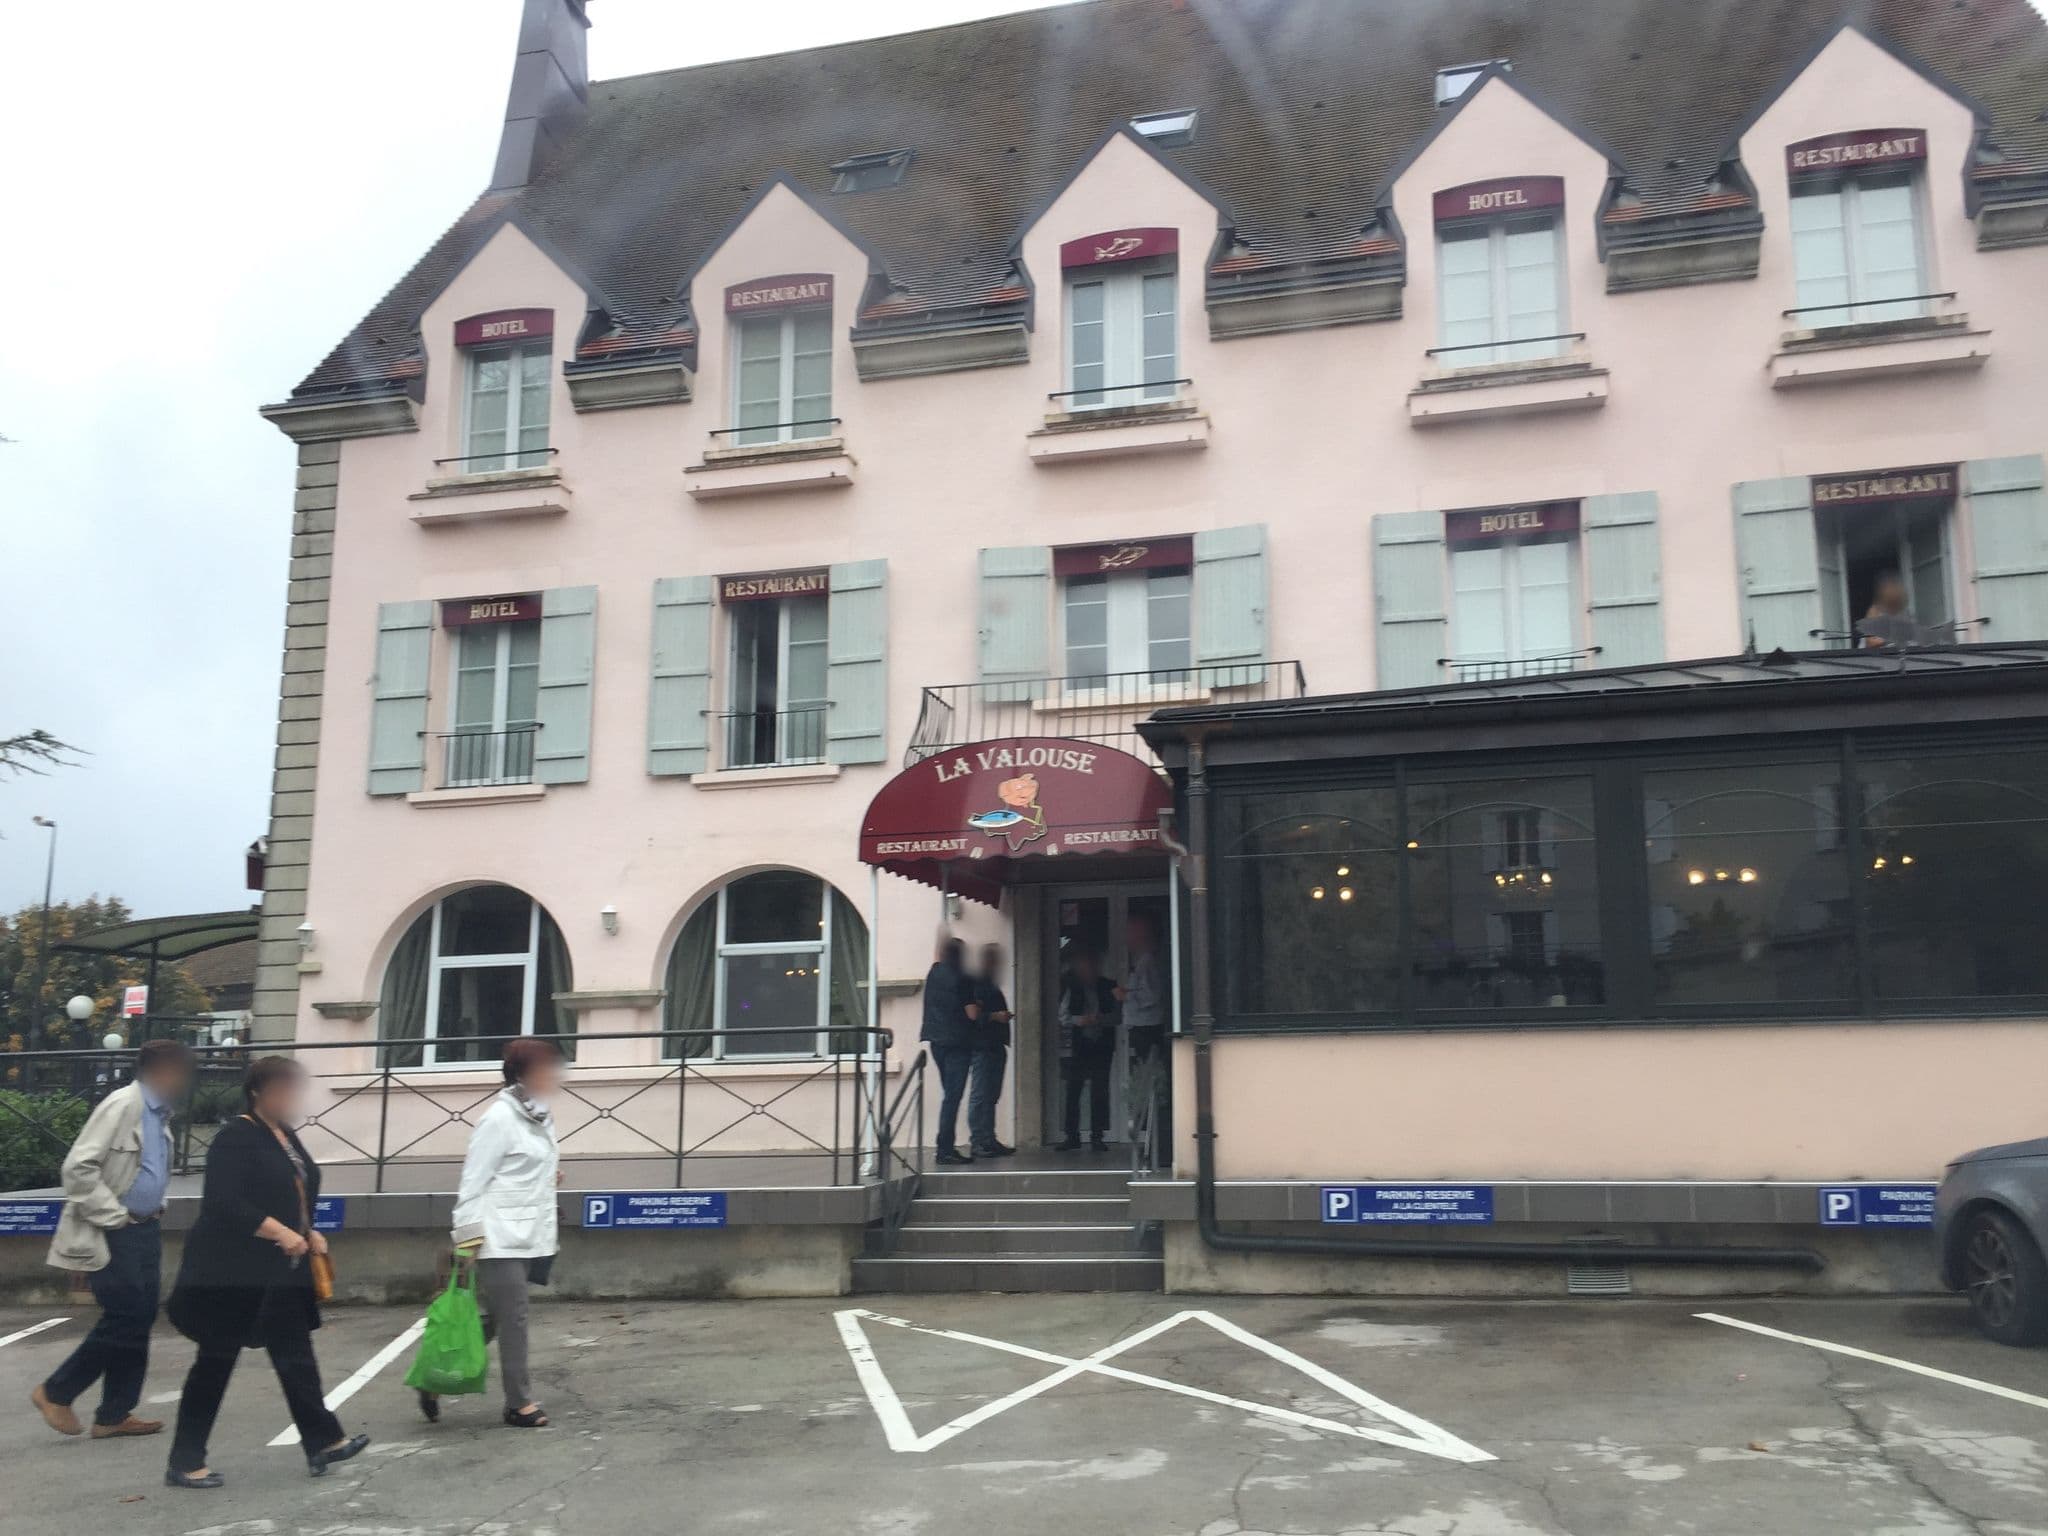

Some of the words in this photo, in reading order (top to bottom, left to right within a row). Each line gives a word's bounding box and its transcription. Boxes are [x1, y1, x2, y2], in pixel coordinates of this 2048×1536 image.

[1792, 136, 1919, 167] RESTAURANT
[1468, 189, 1528, 210] HOTEL
[731, 282, 828, 306] RESTAURANT
[481, 319, 528, 338] HOTEL
[1814, 471, 1951, 501] RESTAURANT
[1479, 511, 1544, 533] HOTEL
[724, 574, 828, 597] RESTAURANT
[469, 601, 519, 619] HOTEL
[935, 757, 973, 783] LA
[976, 746, 1097, 774] VALOUSE
[876, 838, 969, 854] RESTAURANT
[1063, 828, 1160, 845] RESTAURANT
[1329, 1193, 1350, 1218] P
[1375, 1190, 1423, 1200] PARKING
[1828, 1194, 1850, 1219] P
[589, 1200, 607, 1223] P
